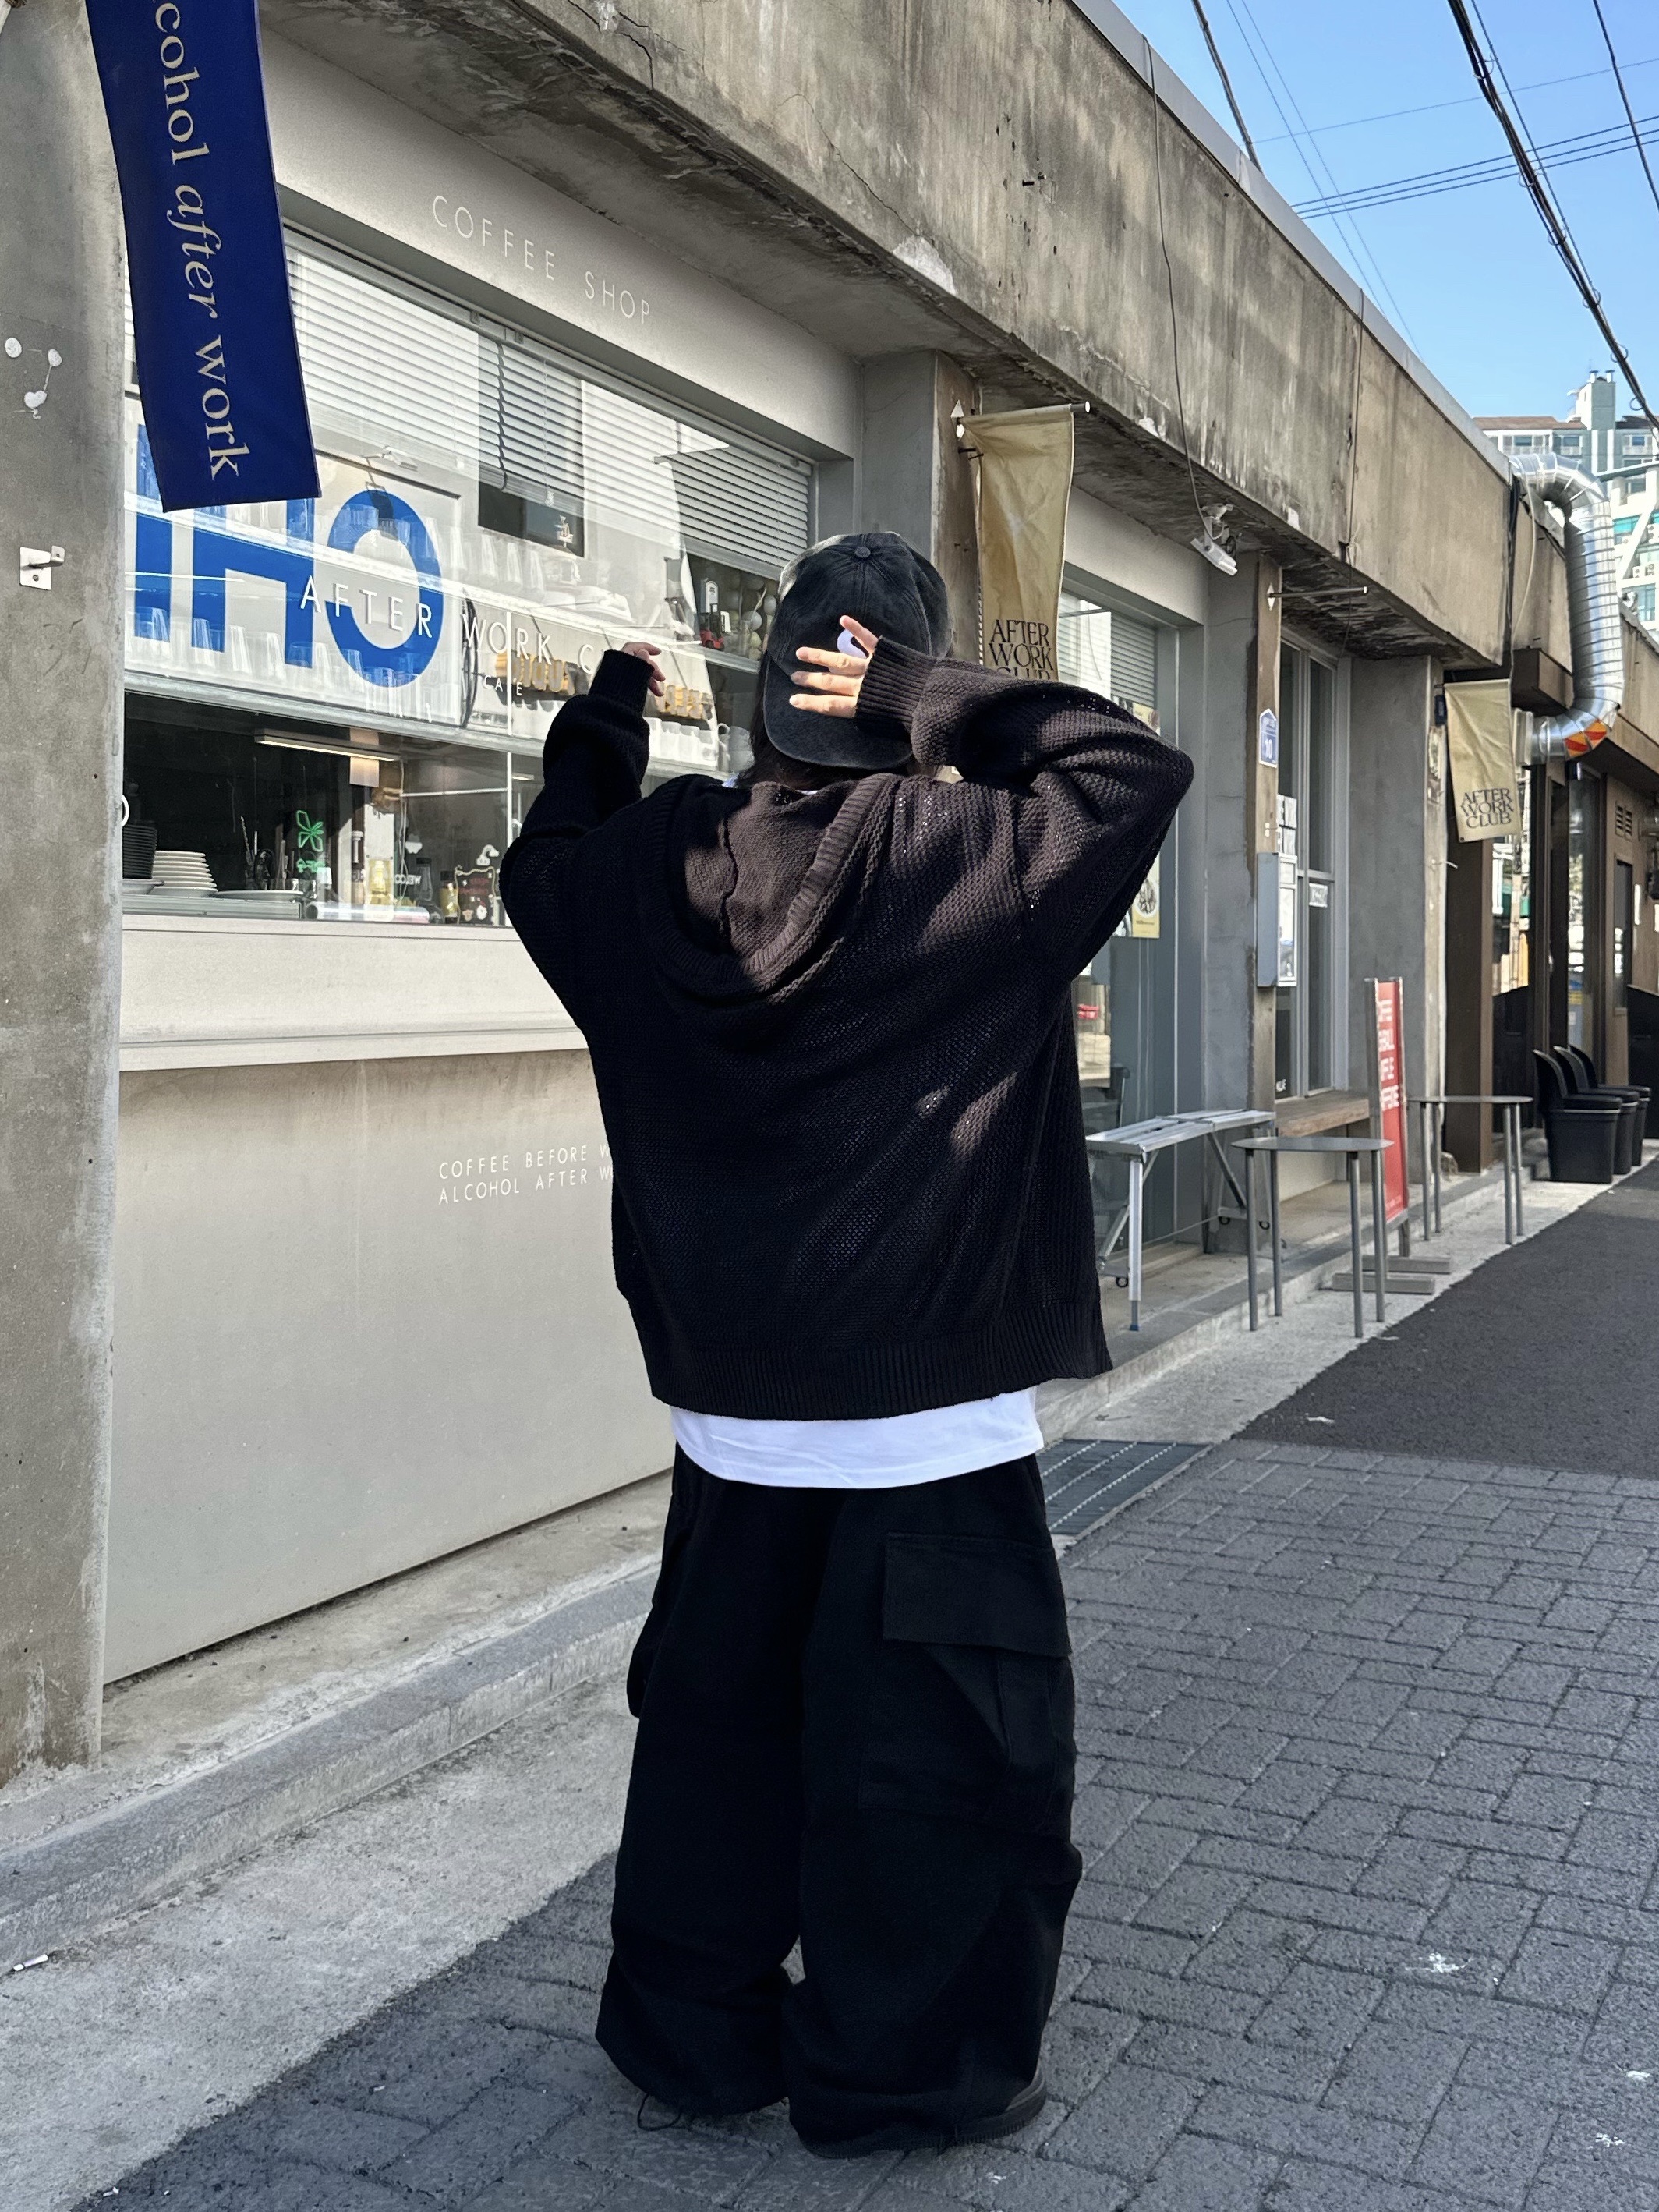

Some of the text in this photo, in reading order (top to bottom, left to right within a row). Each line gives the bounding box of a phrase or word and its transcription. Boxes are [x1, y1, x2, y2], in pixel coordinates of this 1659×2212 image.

[154, 0, 251, 480] cohol after work
[433, 196, 649, 324] COFFEE SHOP
[299, 575, 433, 638] AFTER
[462, 613, 552, 665] WORK
[579, 644, 603, 674] C
[991, 619, 1050, 647] AFTER
[989, 643, 1054, 671] WORK
[483, 675, 522, 696] CAE
[1460, 799, 1514, 817] WORK
[1462, 788, 1512, 805] AFTER
[1466, 812, 1512, 829] CLUB
[439, 1154, 509, 1180] COFFEE
[525, 1145, 587, 1169] BEFORE
[439, 1166, 614, 1205] ALCOHOL AFTER W
